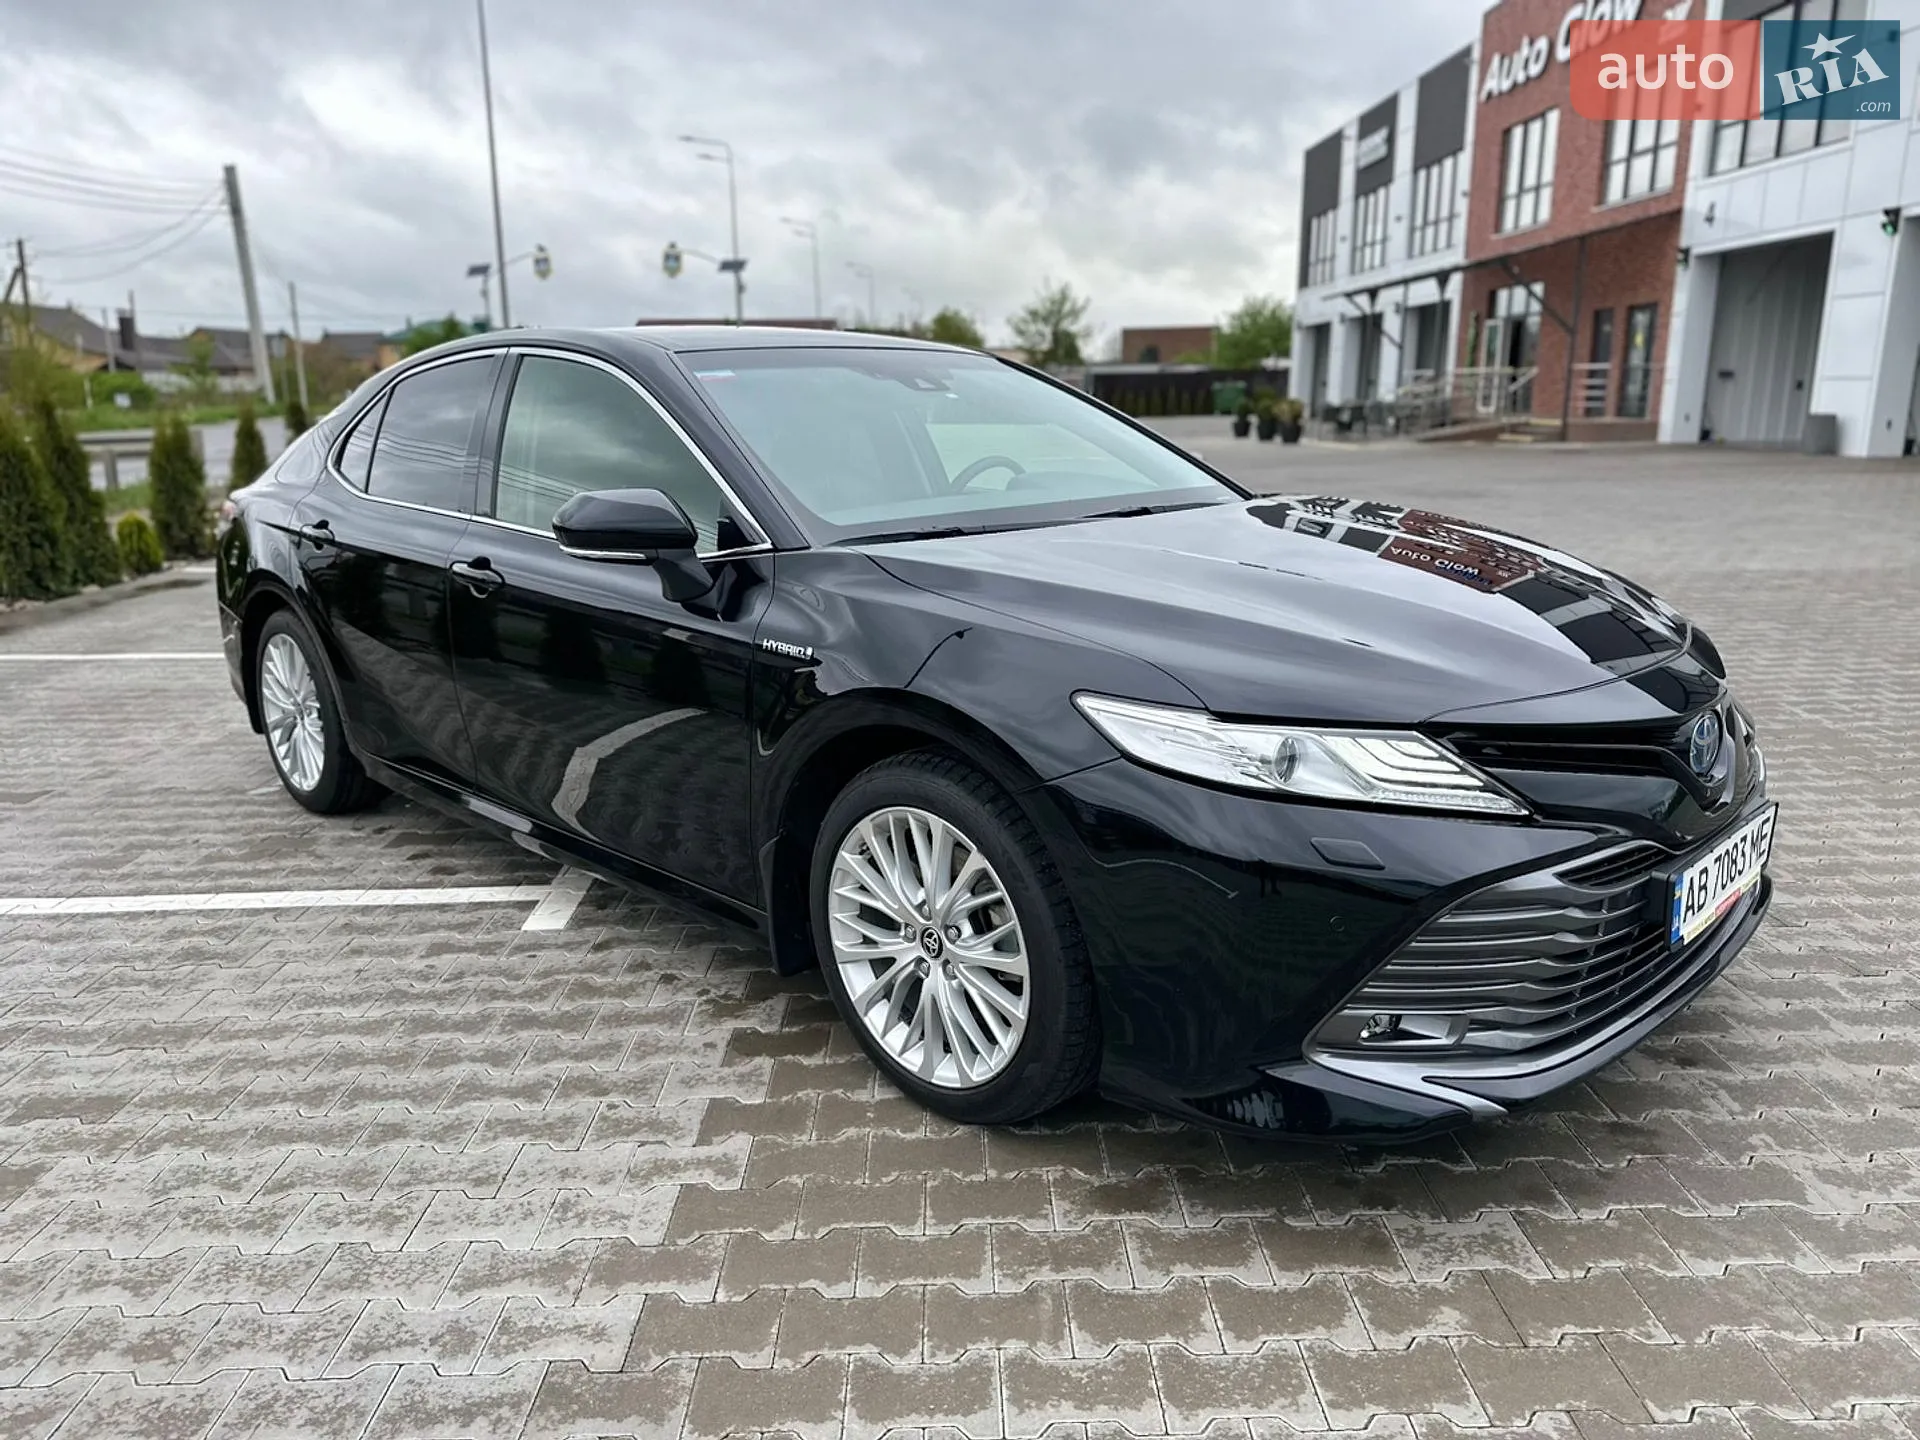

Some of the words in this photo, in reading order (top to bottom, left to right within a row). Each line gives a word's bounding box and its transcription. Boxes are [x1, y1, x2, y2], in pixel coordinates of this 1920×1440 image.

[1480, 34, 1549, 103] Auto
[1556, 0, 1643, 63] Glow
[762, 638, 805, 658] HYBRID
[1683, 866, 1709, 923] AB
[1712, 834, 1748, 900] 7083
[1749, 815, 1771, 869] ME
